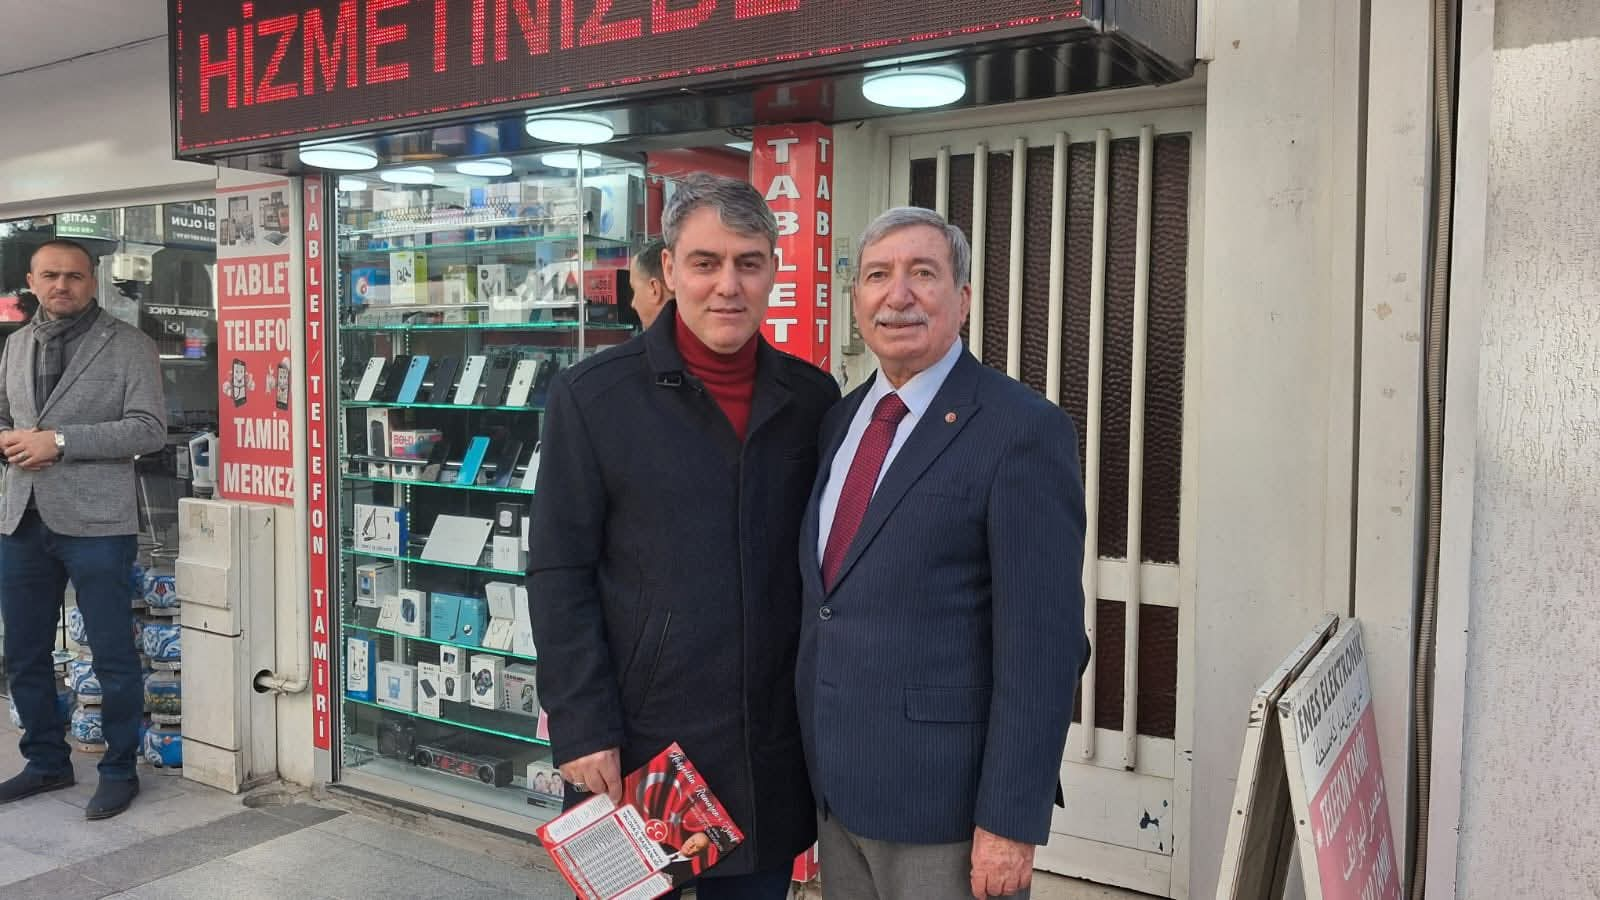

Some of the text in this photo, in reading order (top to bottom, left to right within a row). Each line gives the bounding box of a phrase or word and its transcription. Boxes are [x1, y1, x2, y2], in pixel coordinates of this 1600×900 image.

[199, 0, 800, 113] HİZMETİNİZ
[233, 411, 289, 451] TAMİR
[313, 588, 327, 738] TAMİRİ
[1297, 687, 1322, 744] ENES
[1320, 758, 1352, 848] TELEFON
